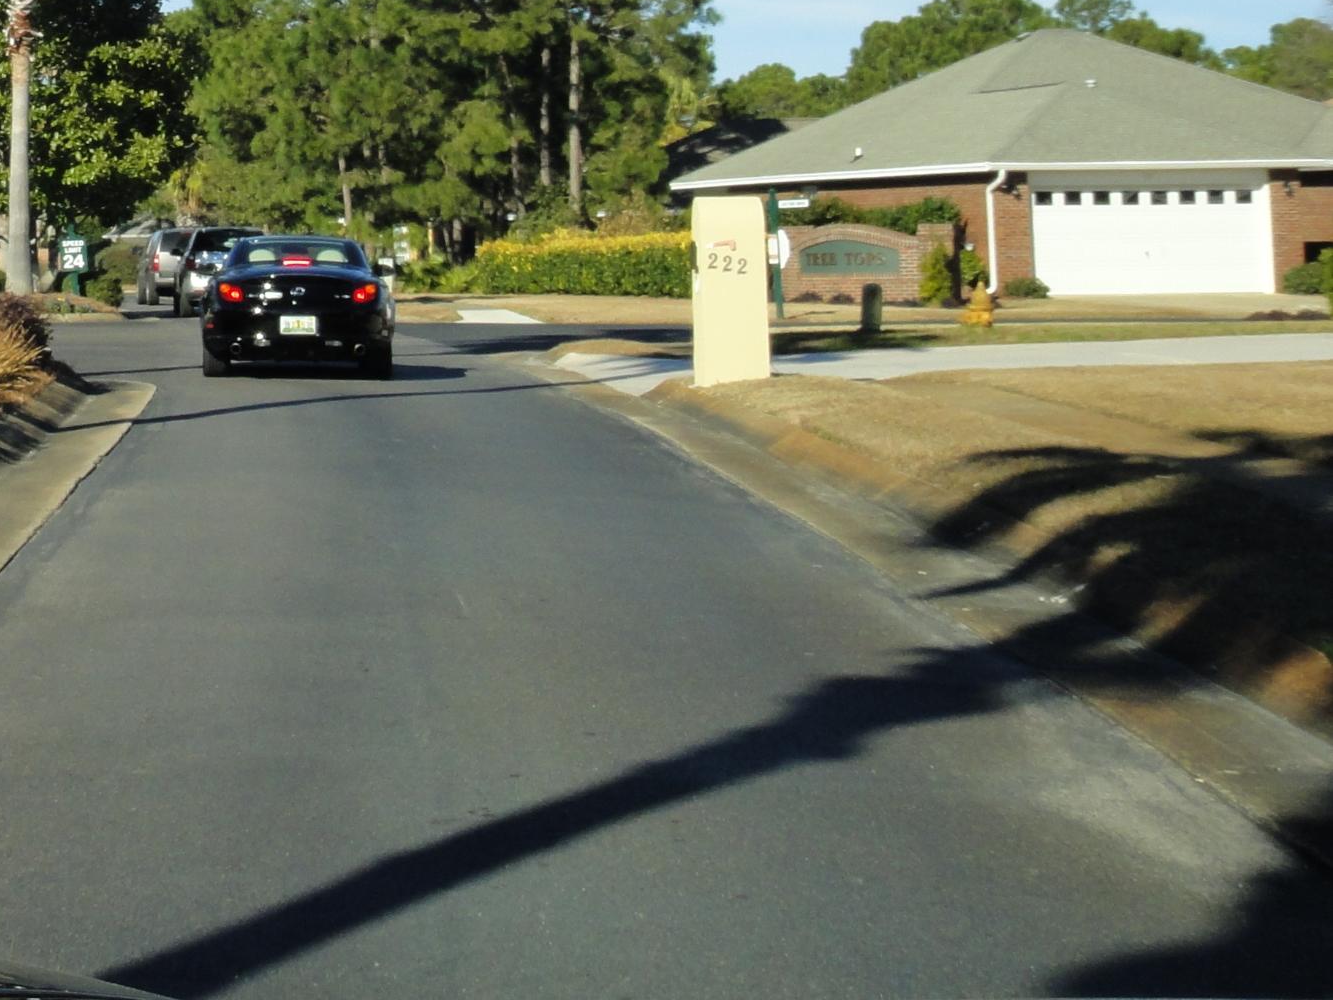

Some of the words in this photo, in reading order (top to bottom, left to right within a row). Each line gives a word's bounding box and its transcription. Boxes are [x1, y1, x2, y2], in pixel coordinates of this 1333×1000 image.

[63, 254, 85, 269] 24
[707, 253, 747, 274] 222
[805, 252, 837, 266] TREE
[844, 252, 885, 266] TOPS
